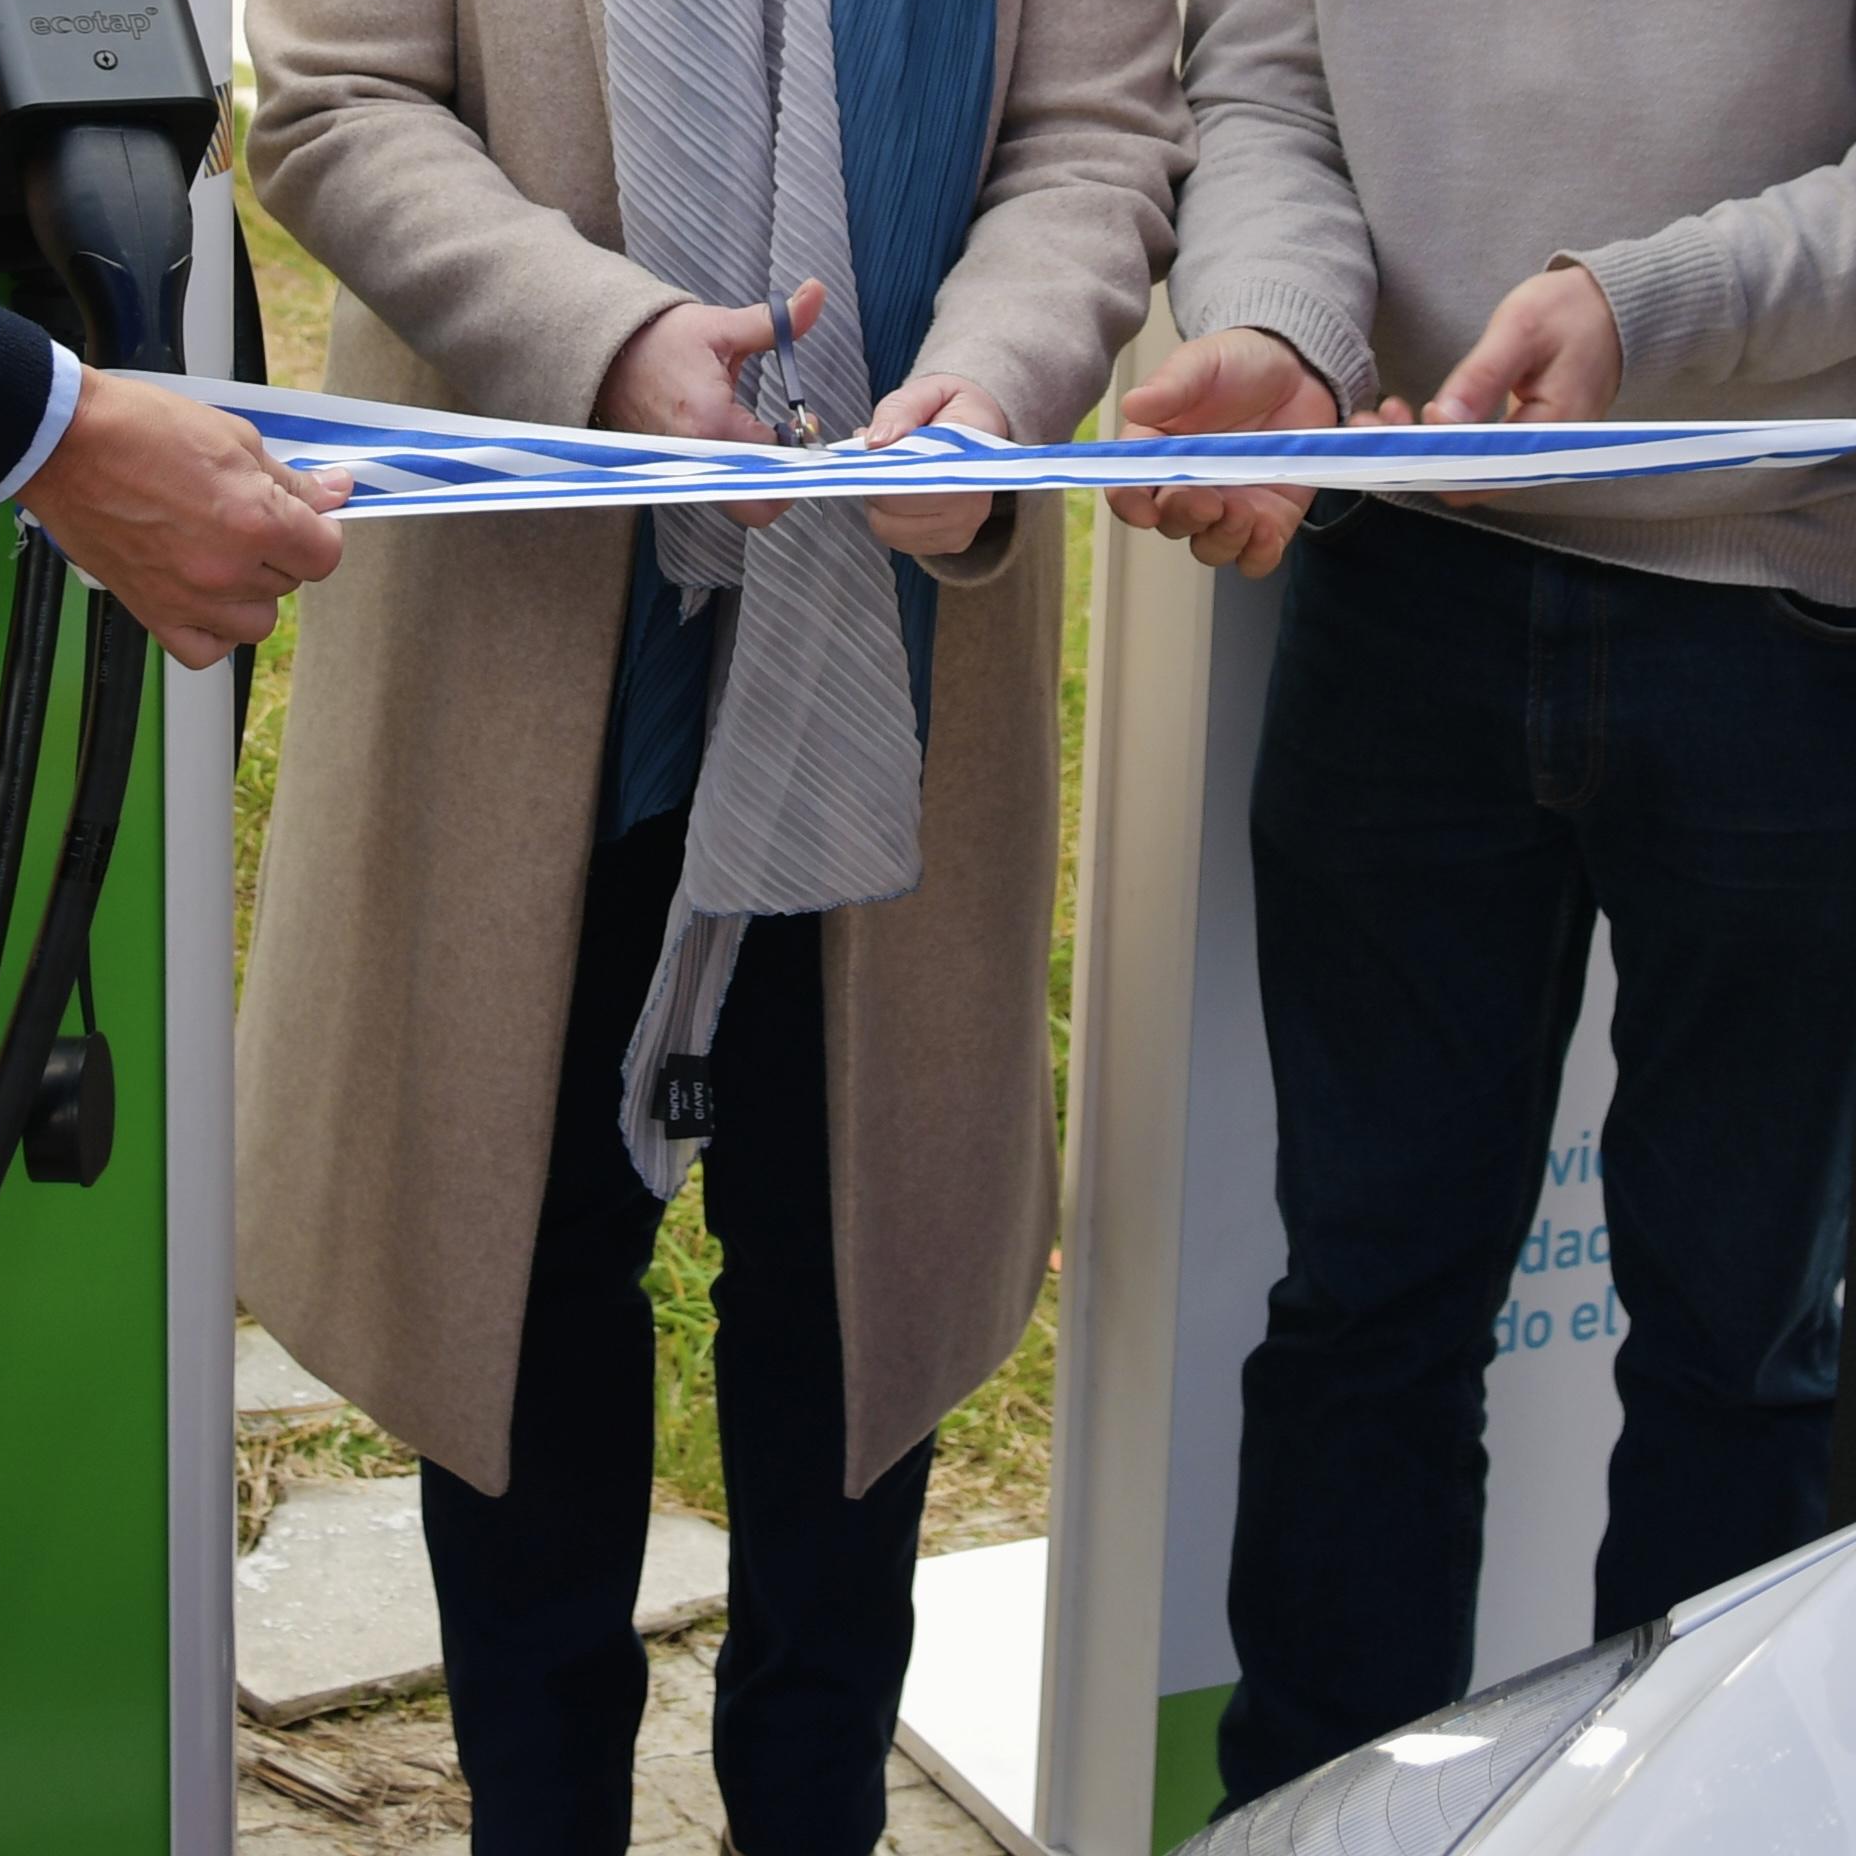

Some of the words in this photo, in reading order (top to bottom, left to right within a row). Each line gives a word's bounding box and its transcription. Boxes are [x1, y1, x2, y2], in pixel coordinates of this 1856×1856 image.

[30, 10, 151, 40] ecotap
[669, 1080, 681, 1121] YOUNG
[692, 1081, 705, 1120] DAVID
[1546, 1130, 1604, 1186] vi
[1570, 1284, 1619, 1342] el
